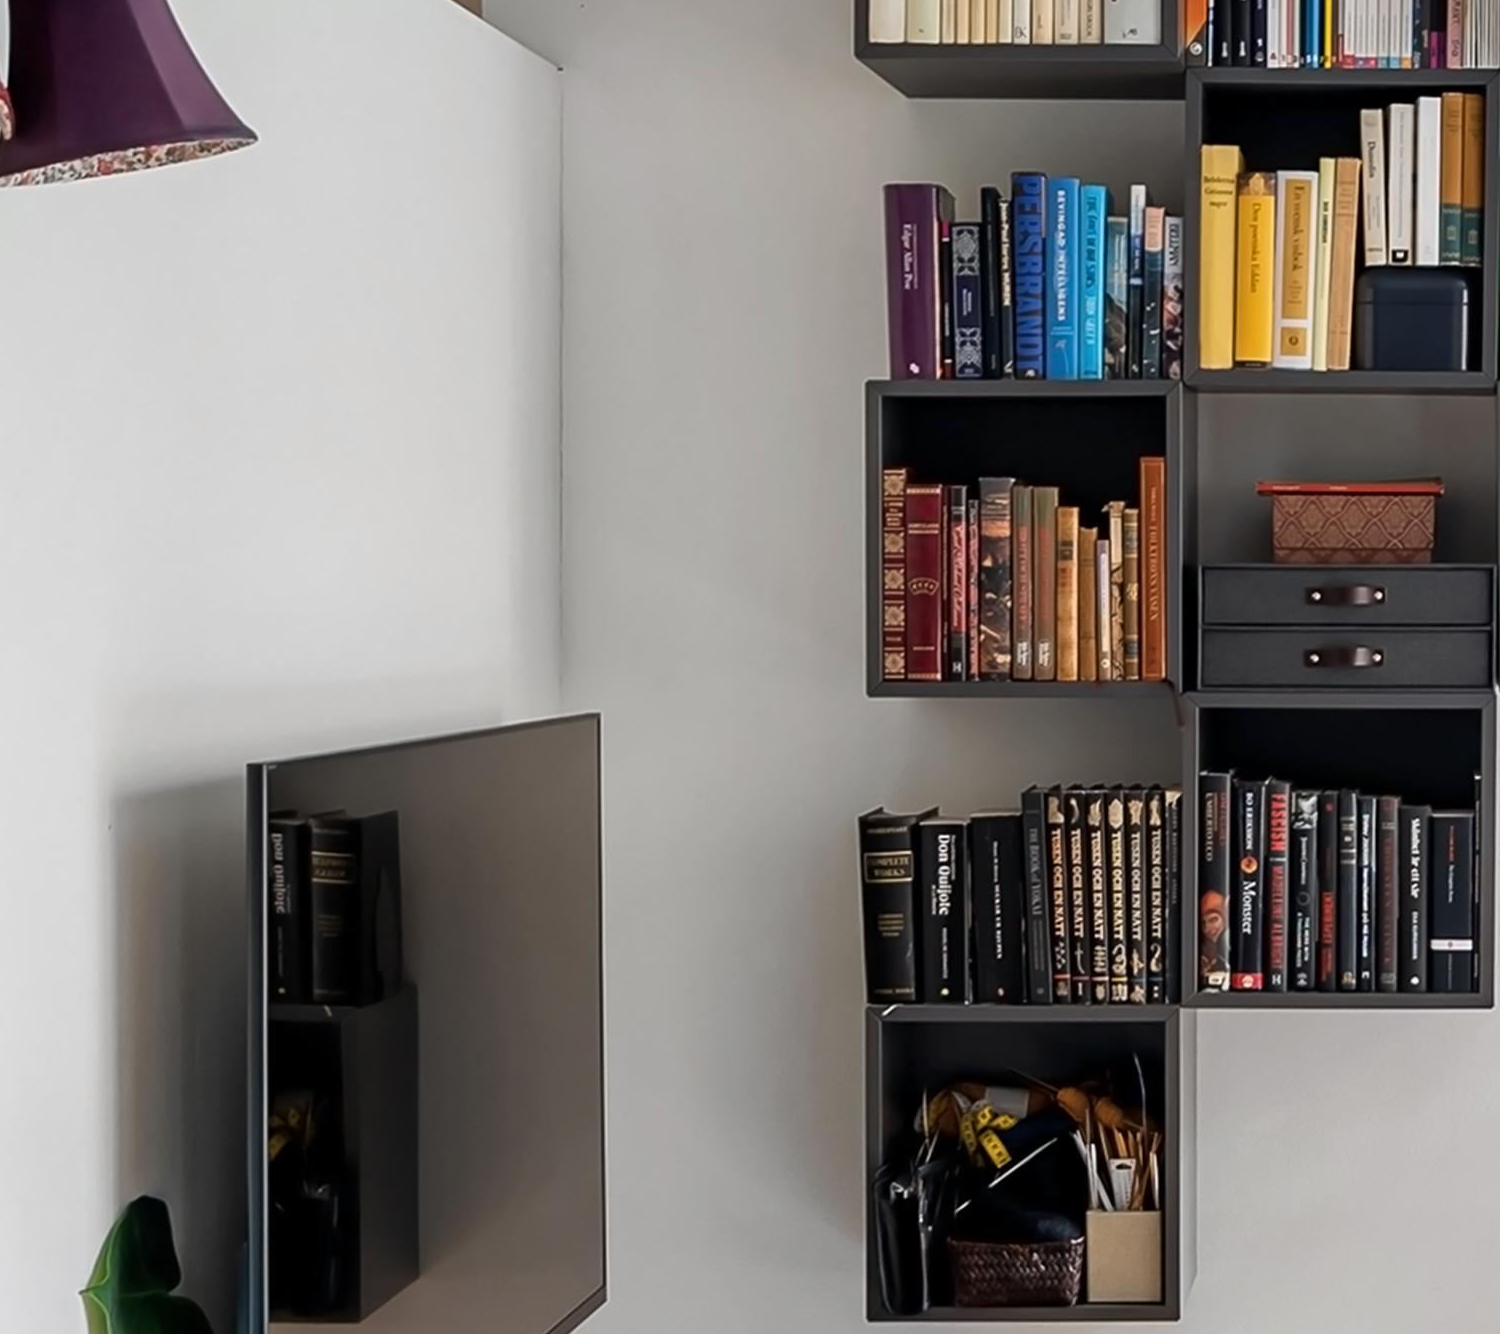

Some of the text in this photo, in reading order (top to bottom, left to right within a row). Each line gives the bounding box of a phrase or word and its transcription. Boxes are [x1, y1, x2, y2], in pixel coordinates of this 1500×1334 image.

[1169, 223, 1179, 267] BELLMAN
[1292, 202, 1305, 235] svensk
[1293, 186, 1306, 201] En
[901, 224, 913, 290] Edgar Allan Poe
[1015, 175, 1043, 371] PERSBRANDT
[1056, 190, 1066, 321] BEVINGAD INTELLIGENS
[1250, 263, 1260, 293] Eddan
[936, 834, 952, 916] Don Quijote
[1051, 828, 1065, 938] TUSEN OCH EN NATT
[1071, 828, 1084, 938] TUSEN OCH EN NATT
[1091, 830, 1104, 940] TUSEN OCH EN NATT
[1111, 831, 1123, 941] TUSEN OCH EN NATT
[1131, 831, 1143, 941] TUSEN OCH EN NATT
[1150, 829, 1162, 939] TUSEN OCH EN NATT
[1205, 841, 1213, 861] ECO
[1241, 792, 1256, 935] BO ERIKSSON Monster
[1270, 793, 1287, 970] FASCISM MADELEINE ALBRIGHT
